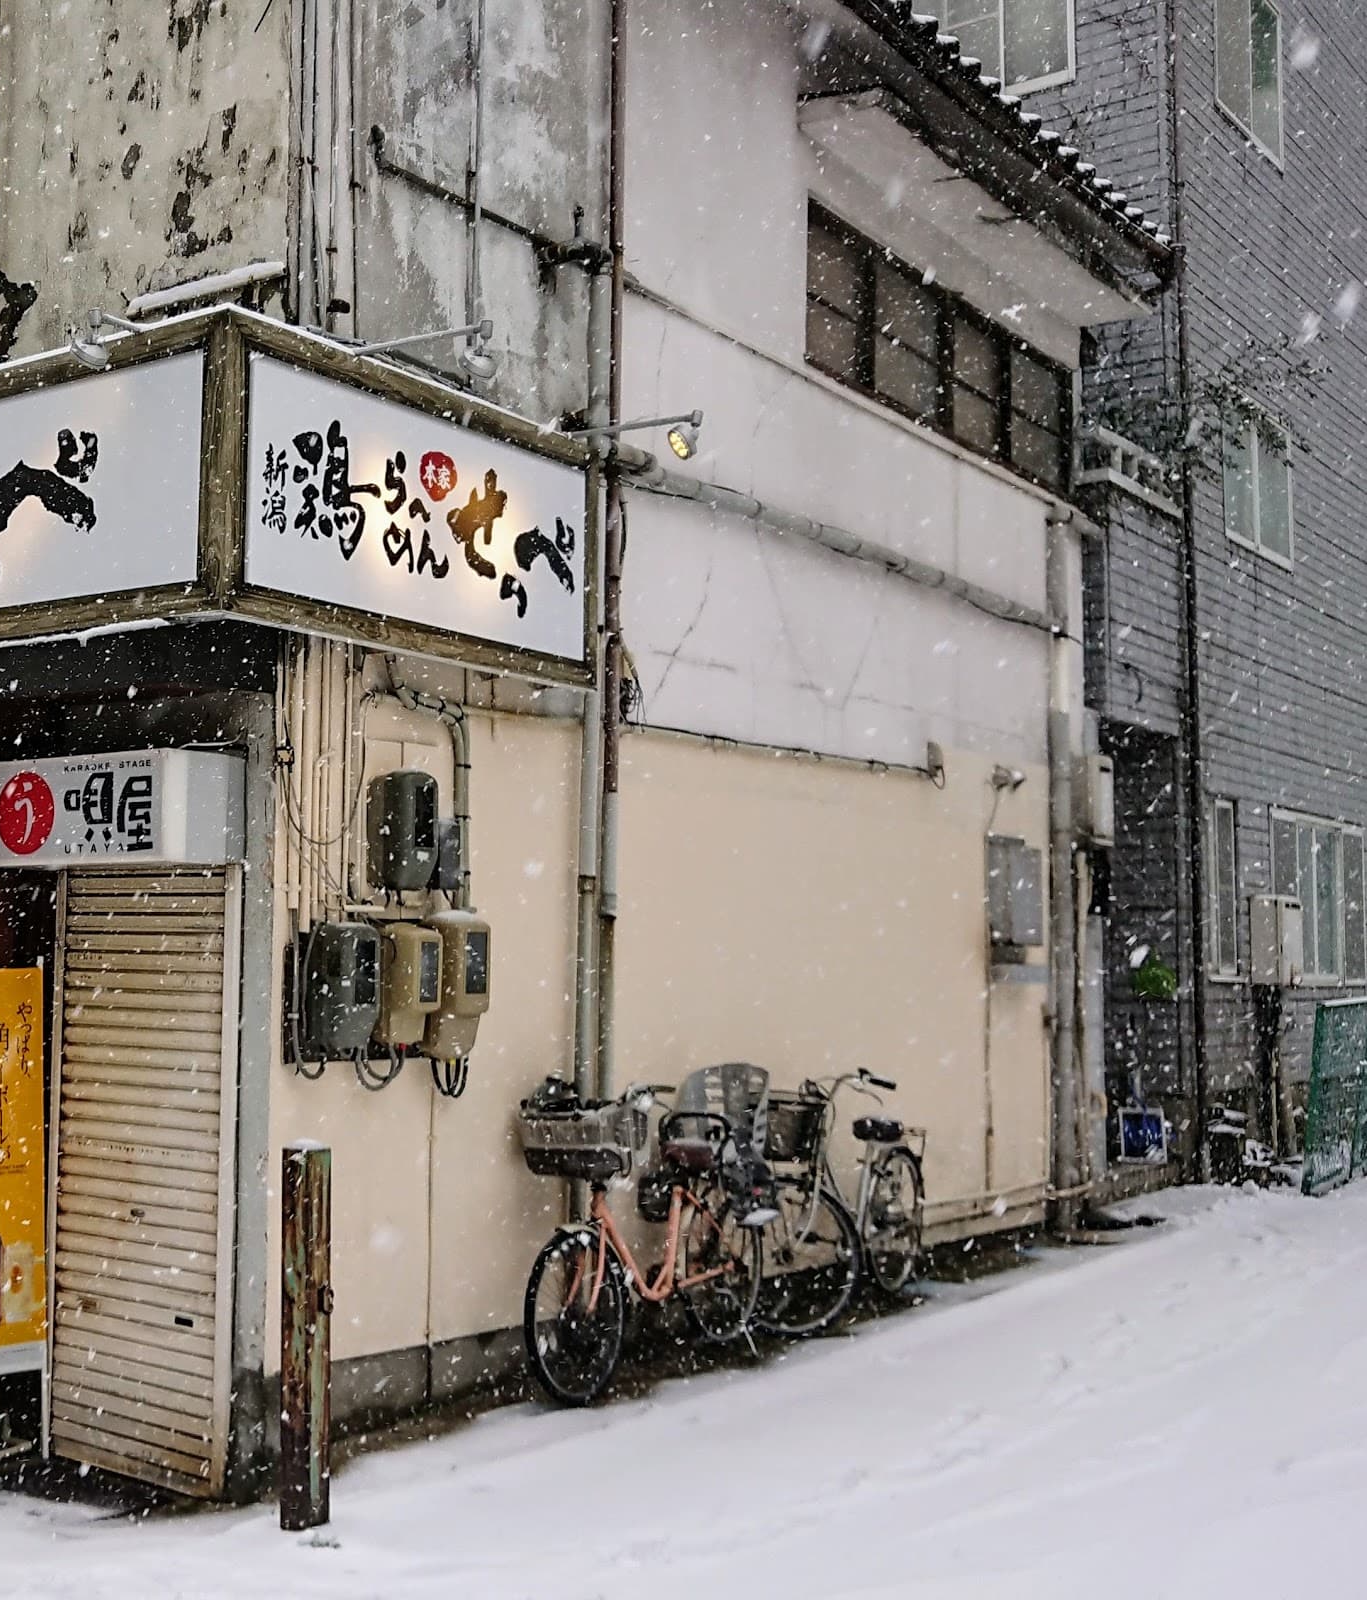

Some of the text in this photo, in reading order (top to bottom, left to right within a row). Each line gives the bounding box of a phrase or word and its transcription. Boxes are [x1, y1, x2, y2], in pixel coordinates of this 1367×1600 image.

[260, 442, 289, 535] 新潟
[422, 459, 452, 491] 本家
[118, 758, 152, 769] STAGE
[63, 772, 154, 852] 唄屋
